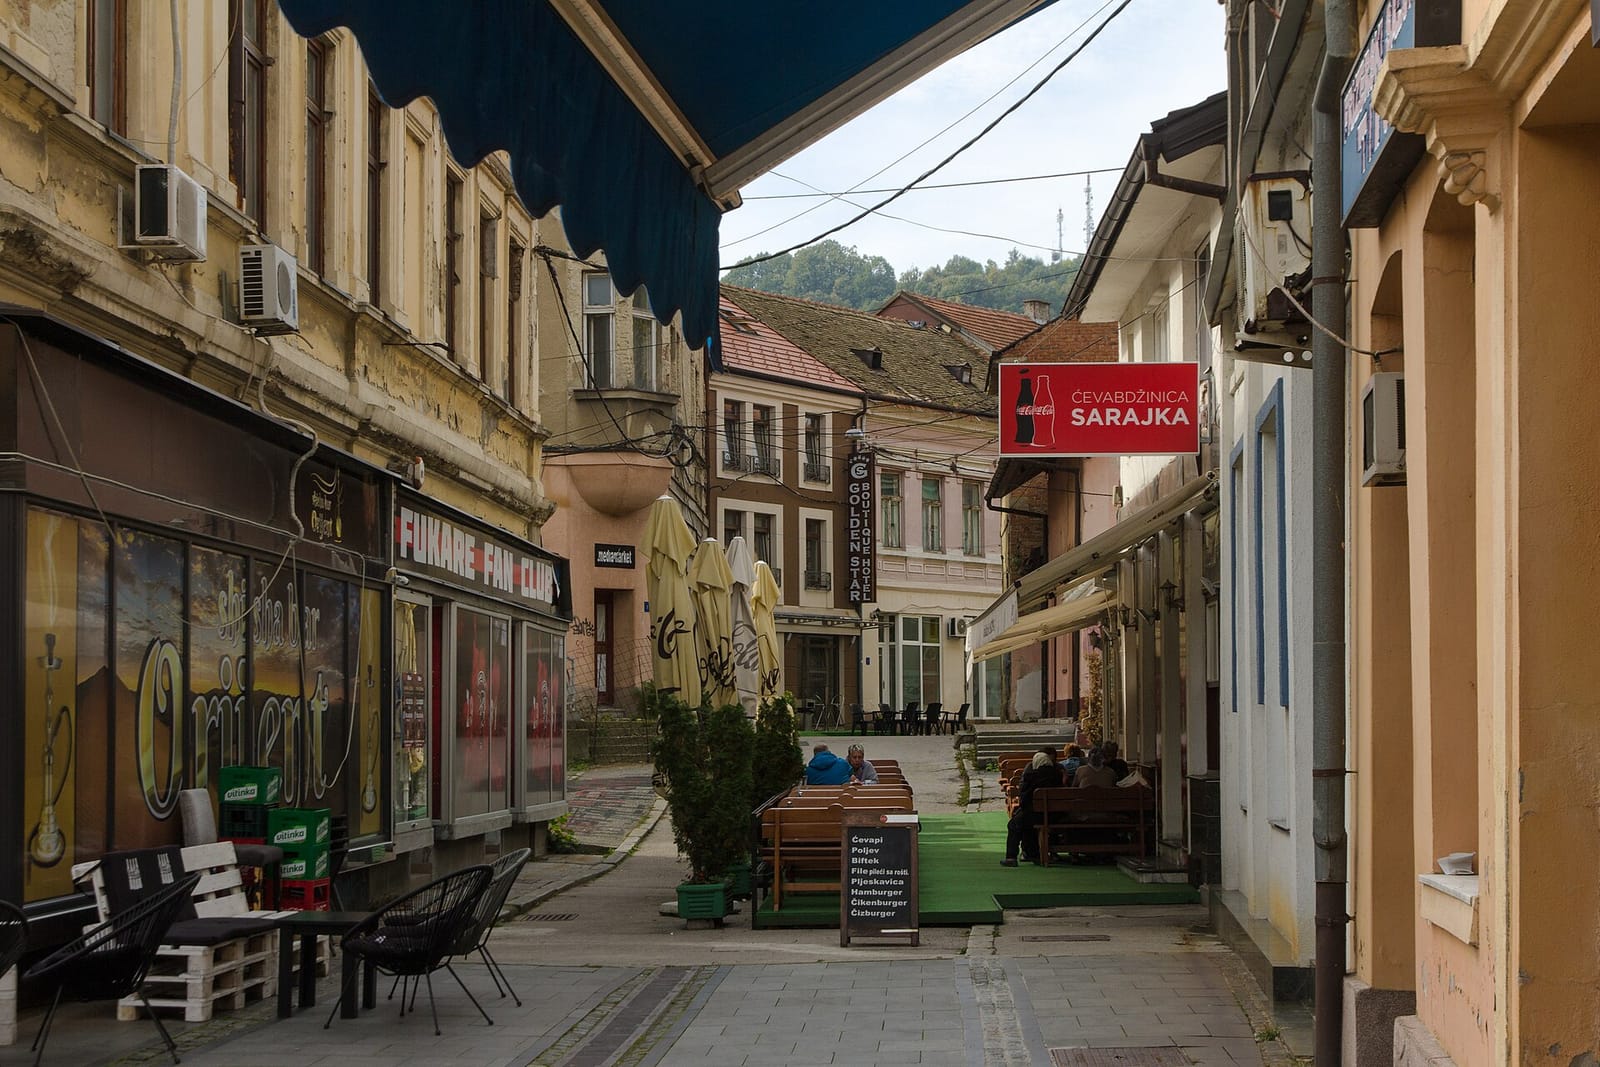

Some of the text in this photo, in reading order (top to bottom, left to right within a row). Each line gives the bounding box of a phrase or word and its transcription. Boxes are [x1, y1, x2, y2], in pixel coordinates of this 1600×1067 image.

[1071, 388, 1189, 404] ĆEVABDŽINICA
[1071, 407, 1190, 427] SARAJKA
[849, 483, 860, 601] GOLDEN STAR
[861, 482, 871, 601] BOUTIQUE HOTEL
[401, 506, 553, 604] FUKARE FAN CLUB
[227, 788, 256, 798] vitinka
[276, 831, 305, 841] vitinka
[281, 863, 304, 874] itinka
[851, 867, 868, 875] File
[851, 878, 904, 886] Pljeskavica
